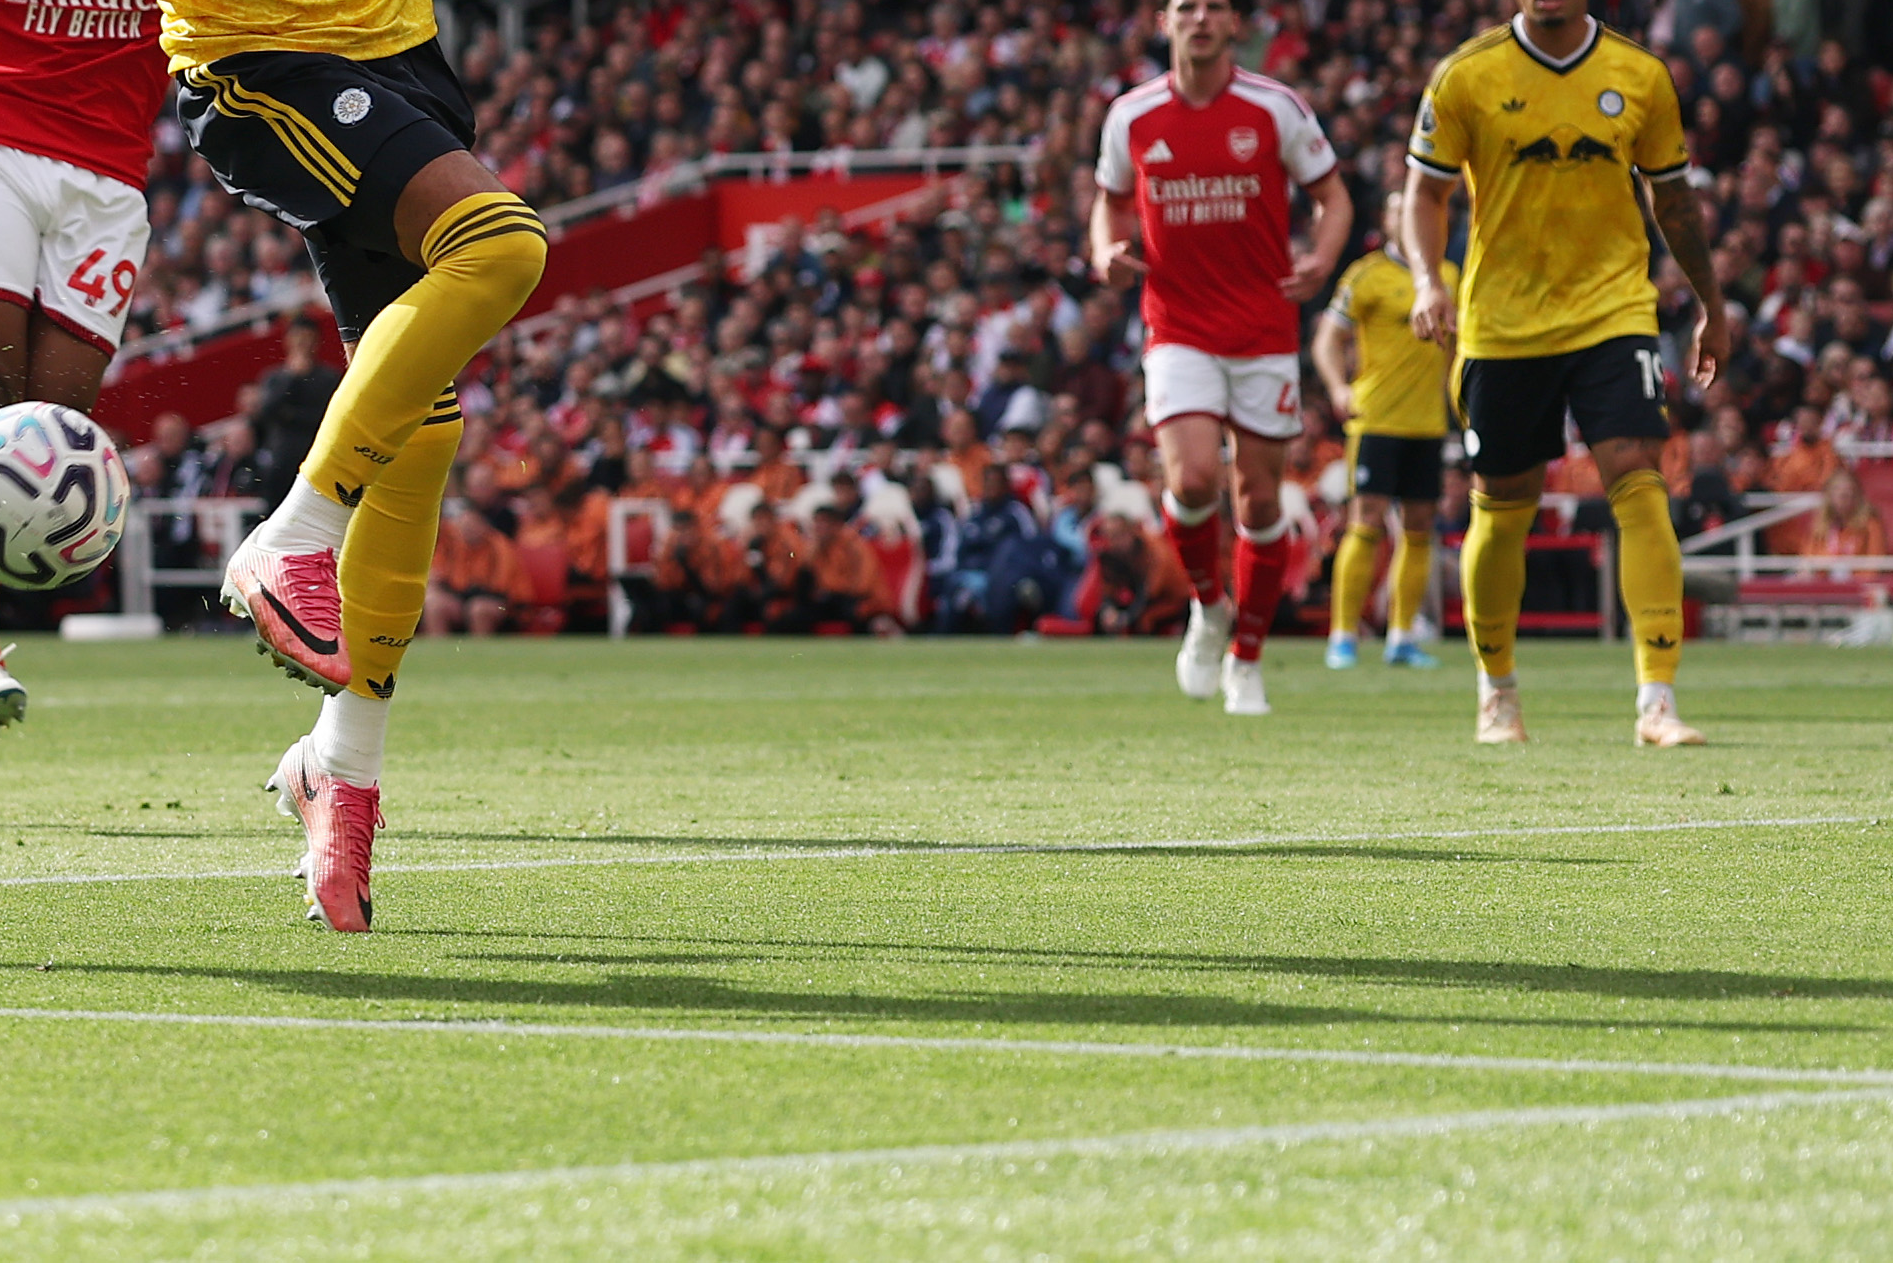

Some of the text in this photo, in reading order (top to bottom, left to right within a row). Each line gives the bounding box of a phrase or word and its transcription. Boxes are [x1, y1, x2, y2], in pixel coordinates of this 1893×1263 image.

[24, 4, 142, 38] FLY BETTER
[1148, 173, 1261, 205] Emirates
[67, 247, 138, 317] 49
